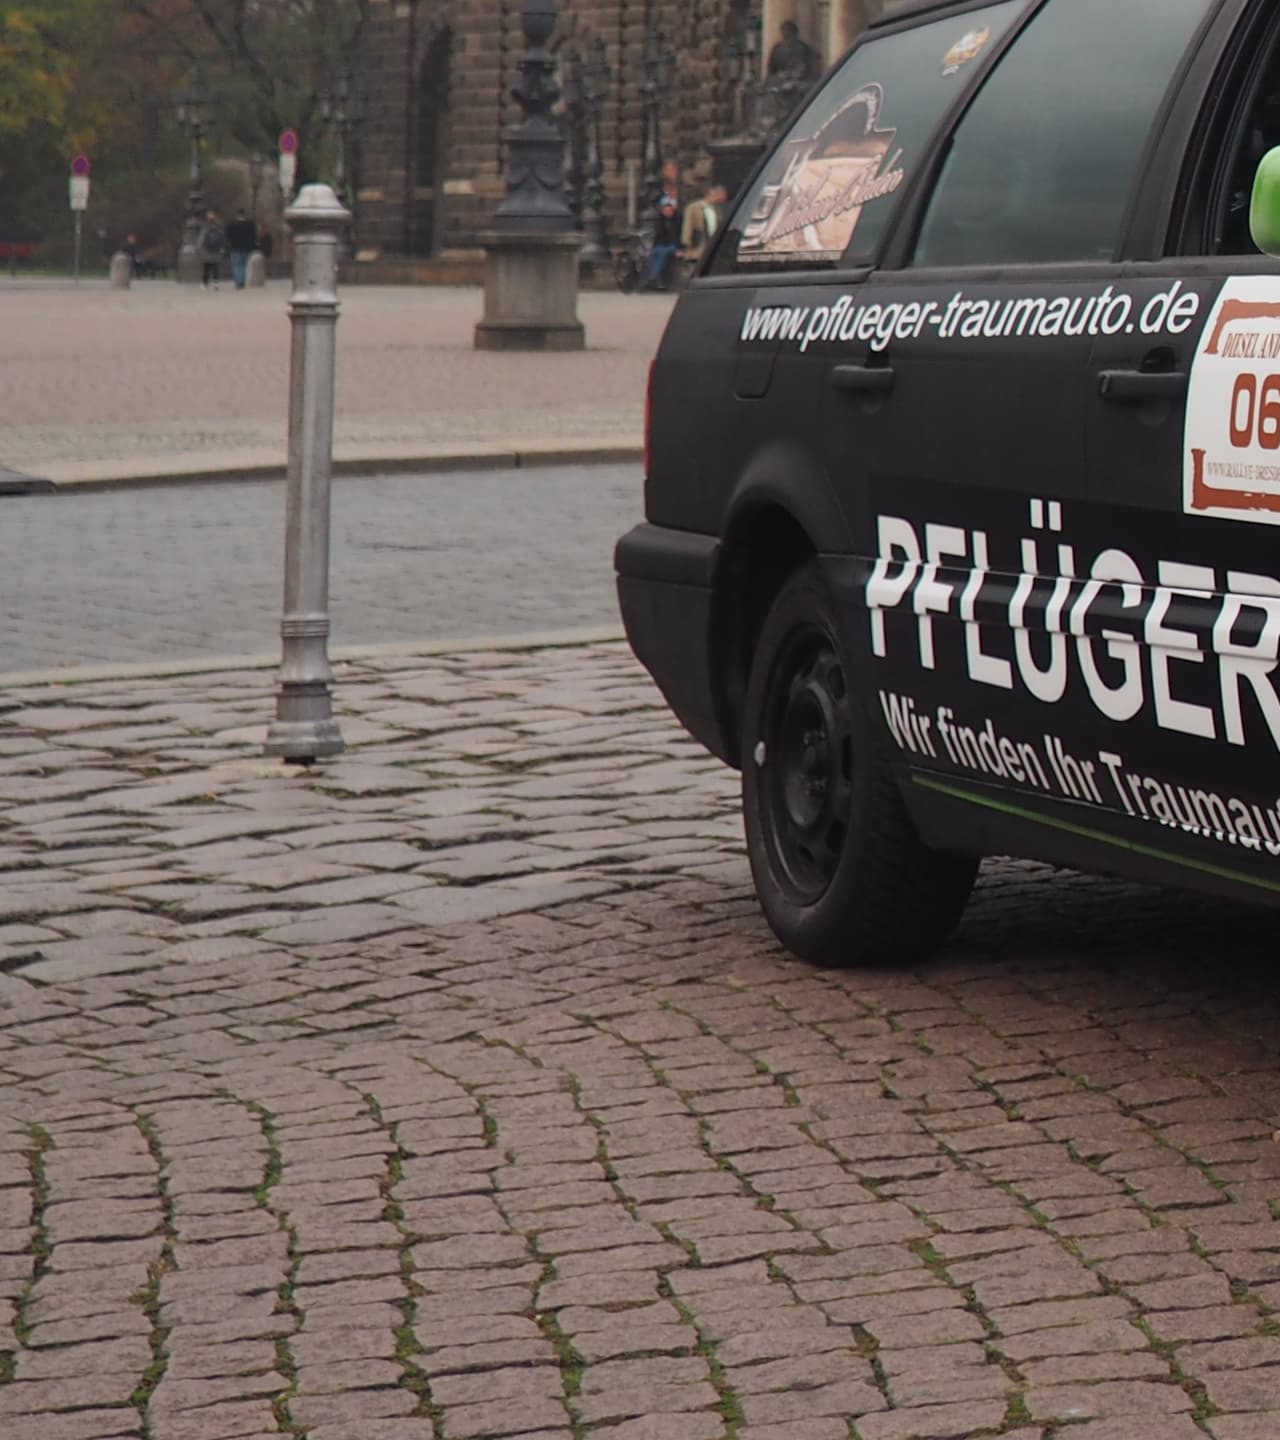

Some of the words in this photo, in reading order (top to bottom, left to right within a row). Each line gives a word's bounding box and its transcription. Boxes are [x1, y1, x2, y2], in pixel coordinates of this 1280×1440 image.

[739, 280, 1200, 353] www.pflueger-traumauto.de
[1221, 332, 1260, 358] DIESEL
[878, 690, 937, 757] Wir
[936, 705, 1050, 791] finden
[1043, 733, 1102, 805] Ihr
